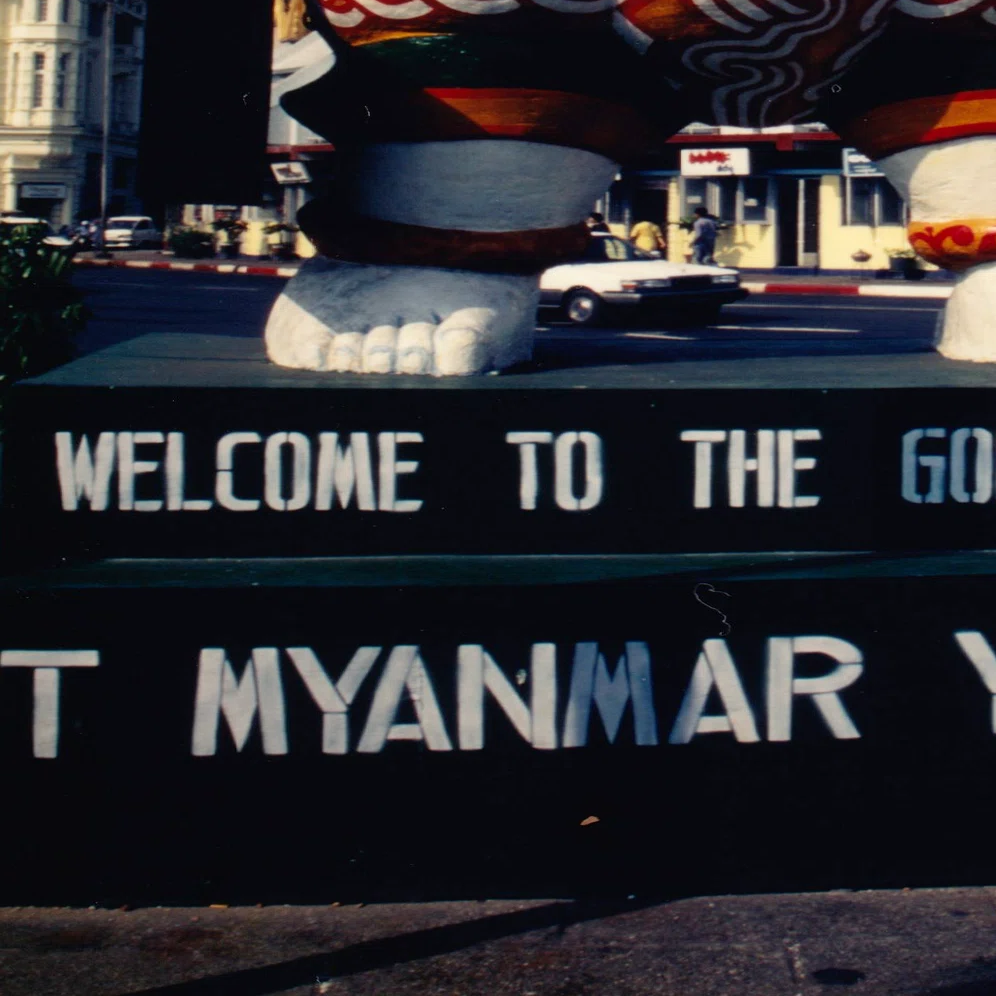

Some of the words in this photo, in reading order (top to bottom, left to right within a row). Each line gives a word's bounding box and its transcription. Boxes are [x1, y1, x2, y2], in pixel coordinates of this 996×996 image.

[54, 431, 424, 513] WELCOME
[505, 430, 604, 511] TO
[680, 428, 823, 509] THE
[190, 634, 864, 757] MYANMAR
